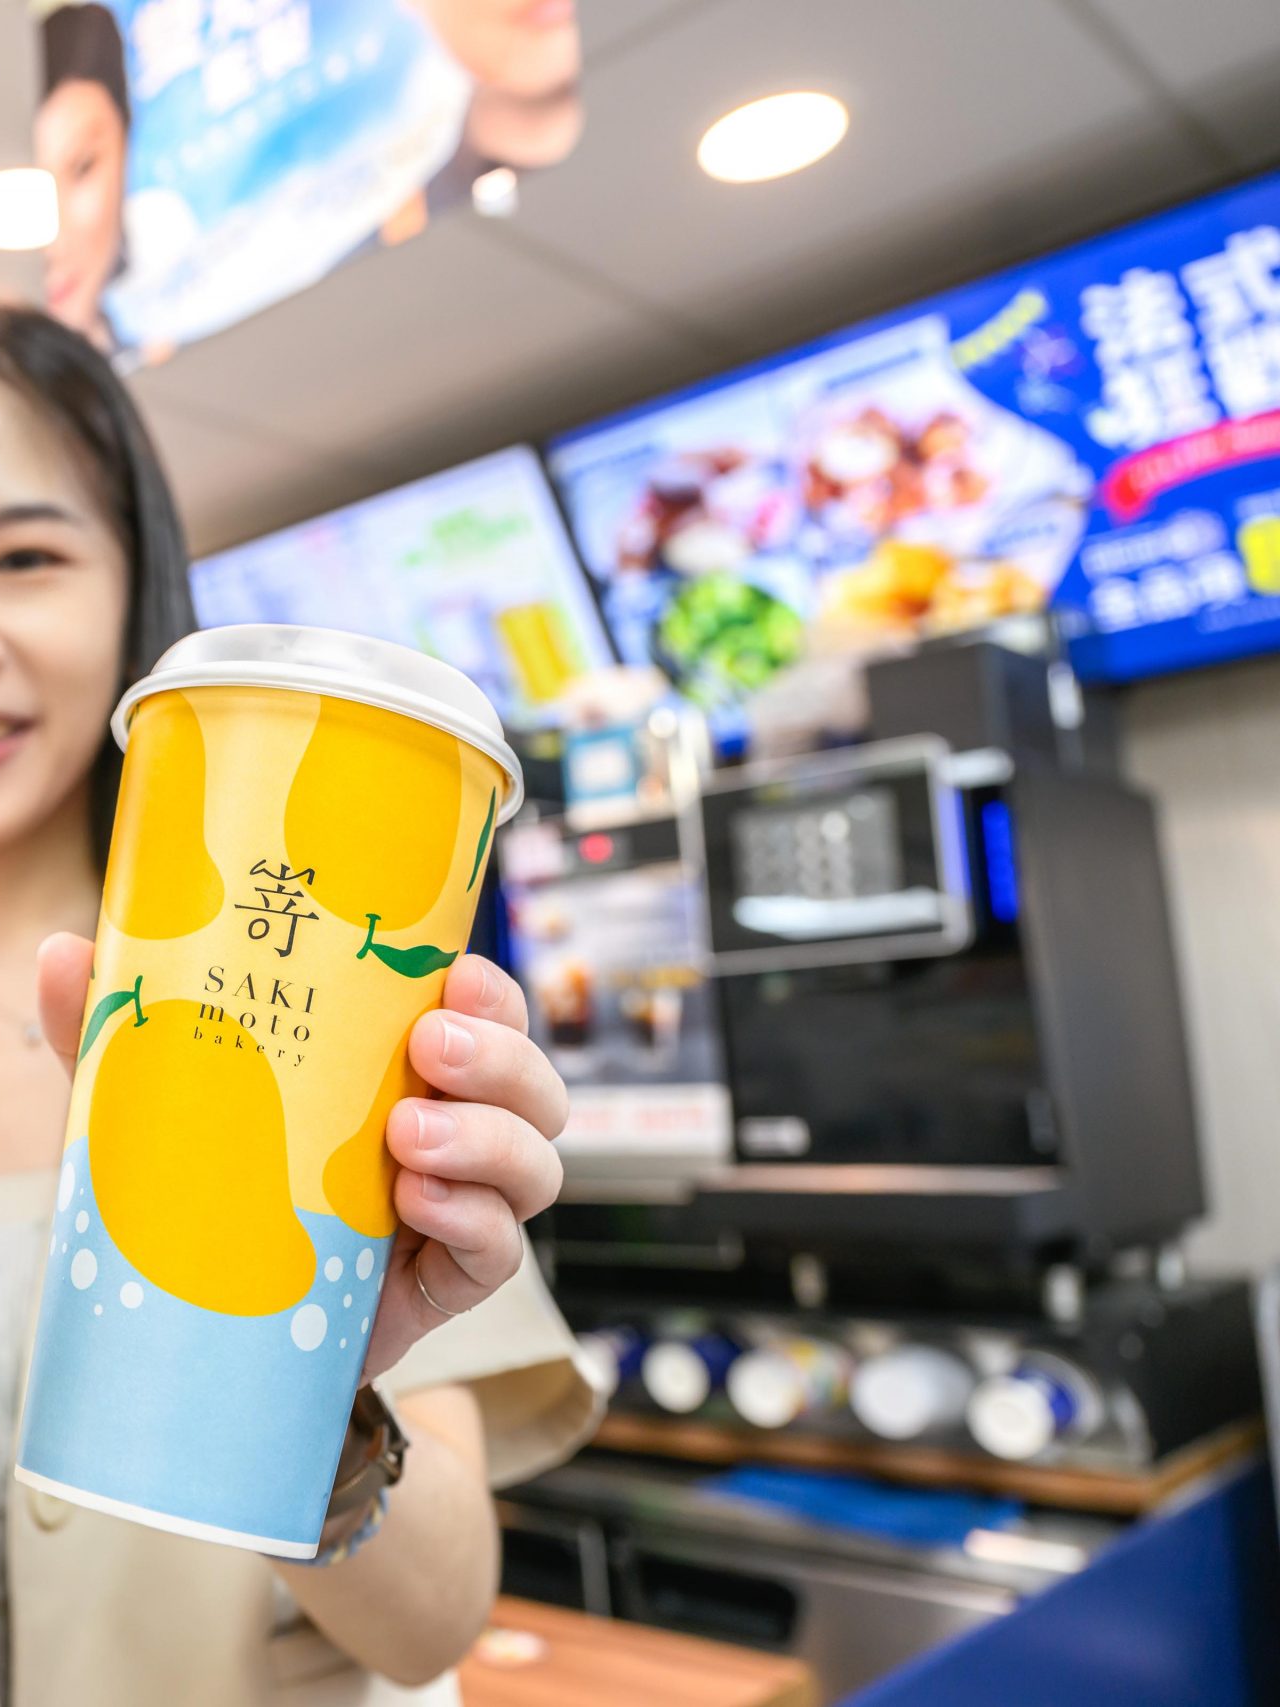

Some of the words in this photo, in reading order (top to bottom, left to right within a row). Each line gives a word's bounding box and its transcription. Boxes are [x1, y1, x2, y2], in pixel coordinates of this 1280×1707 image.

[204, 965, 318, 1015] SAKI
[199, 1002, 311, 1042] moto
[193, 1026, 306, 1067] bakery
